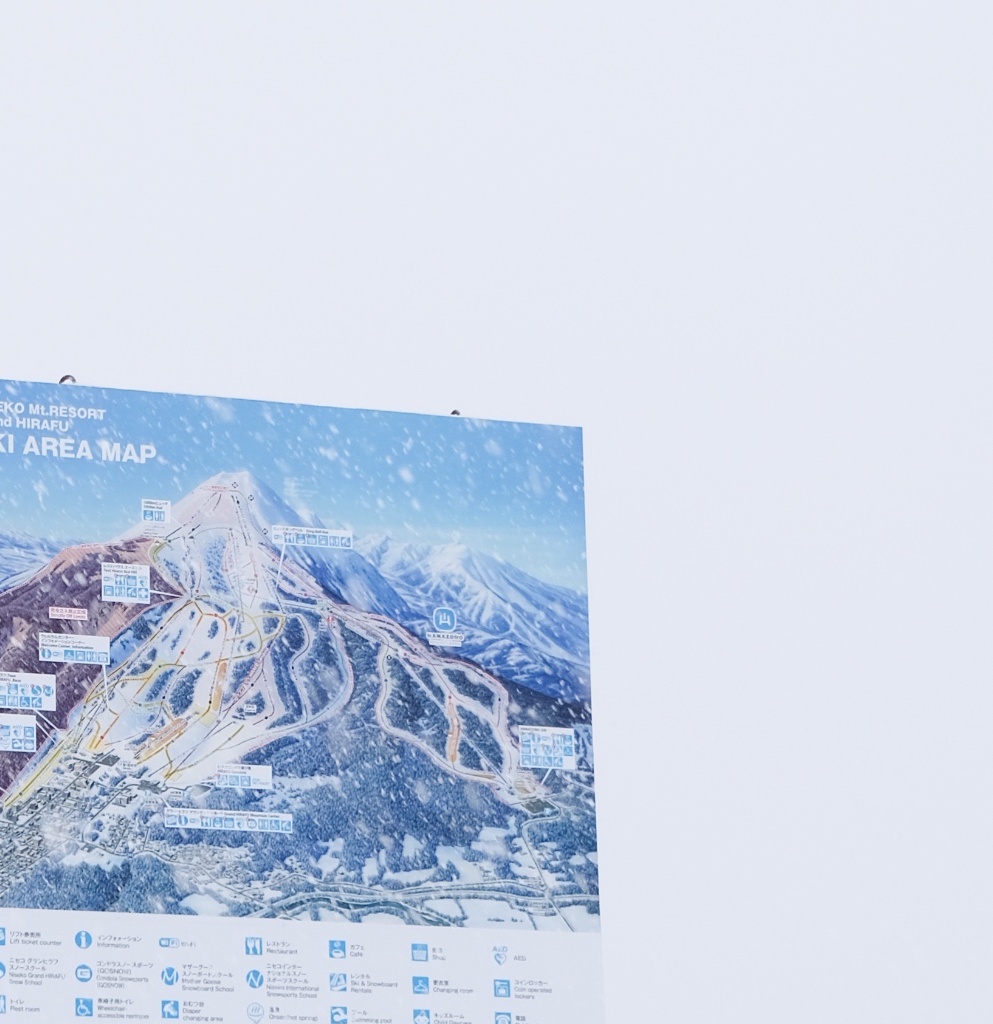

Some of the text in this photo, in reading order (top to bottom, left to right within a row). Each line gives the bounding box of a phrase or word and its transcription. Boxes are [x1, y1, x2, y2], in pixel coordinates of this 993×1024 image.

[29, 404, 106, 420] Mt.RESORT
[16, 418, 69, 432] HIRAFU
[23, 436, 93, 459] AREA
[102, 443, 156, 464] MAP
